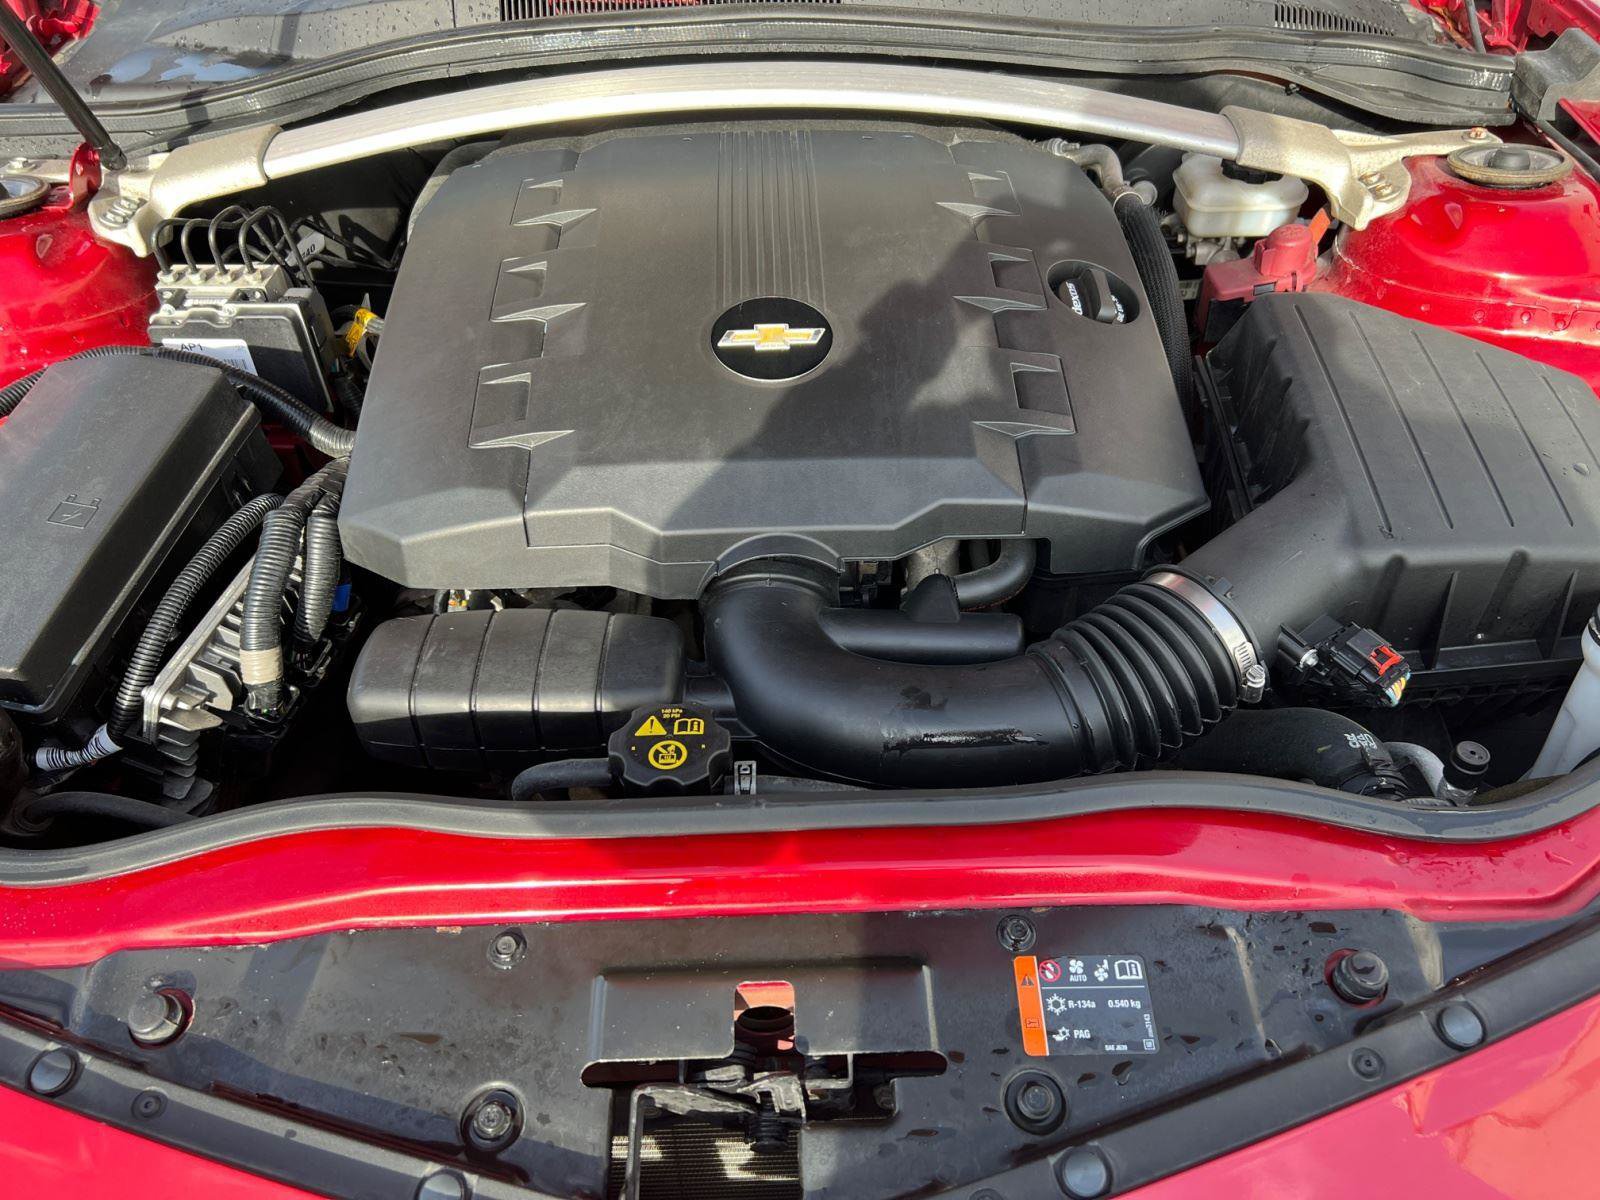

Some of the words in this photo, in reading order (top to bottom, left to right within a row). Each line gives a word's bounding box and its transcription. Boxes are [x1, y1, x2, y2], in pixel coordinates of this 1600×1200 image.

[1068, 1000, 1096, 1009] R-134a
[1108, 999, 1129, 1008] 0.540
[1130, 999, 1141, 1009] kg
[1073, 1029, 1091, 1039] PAG
